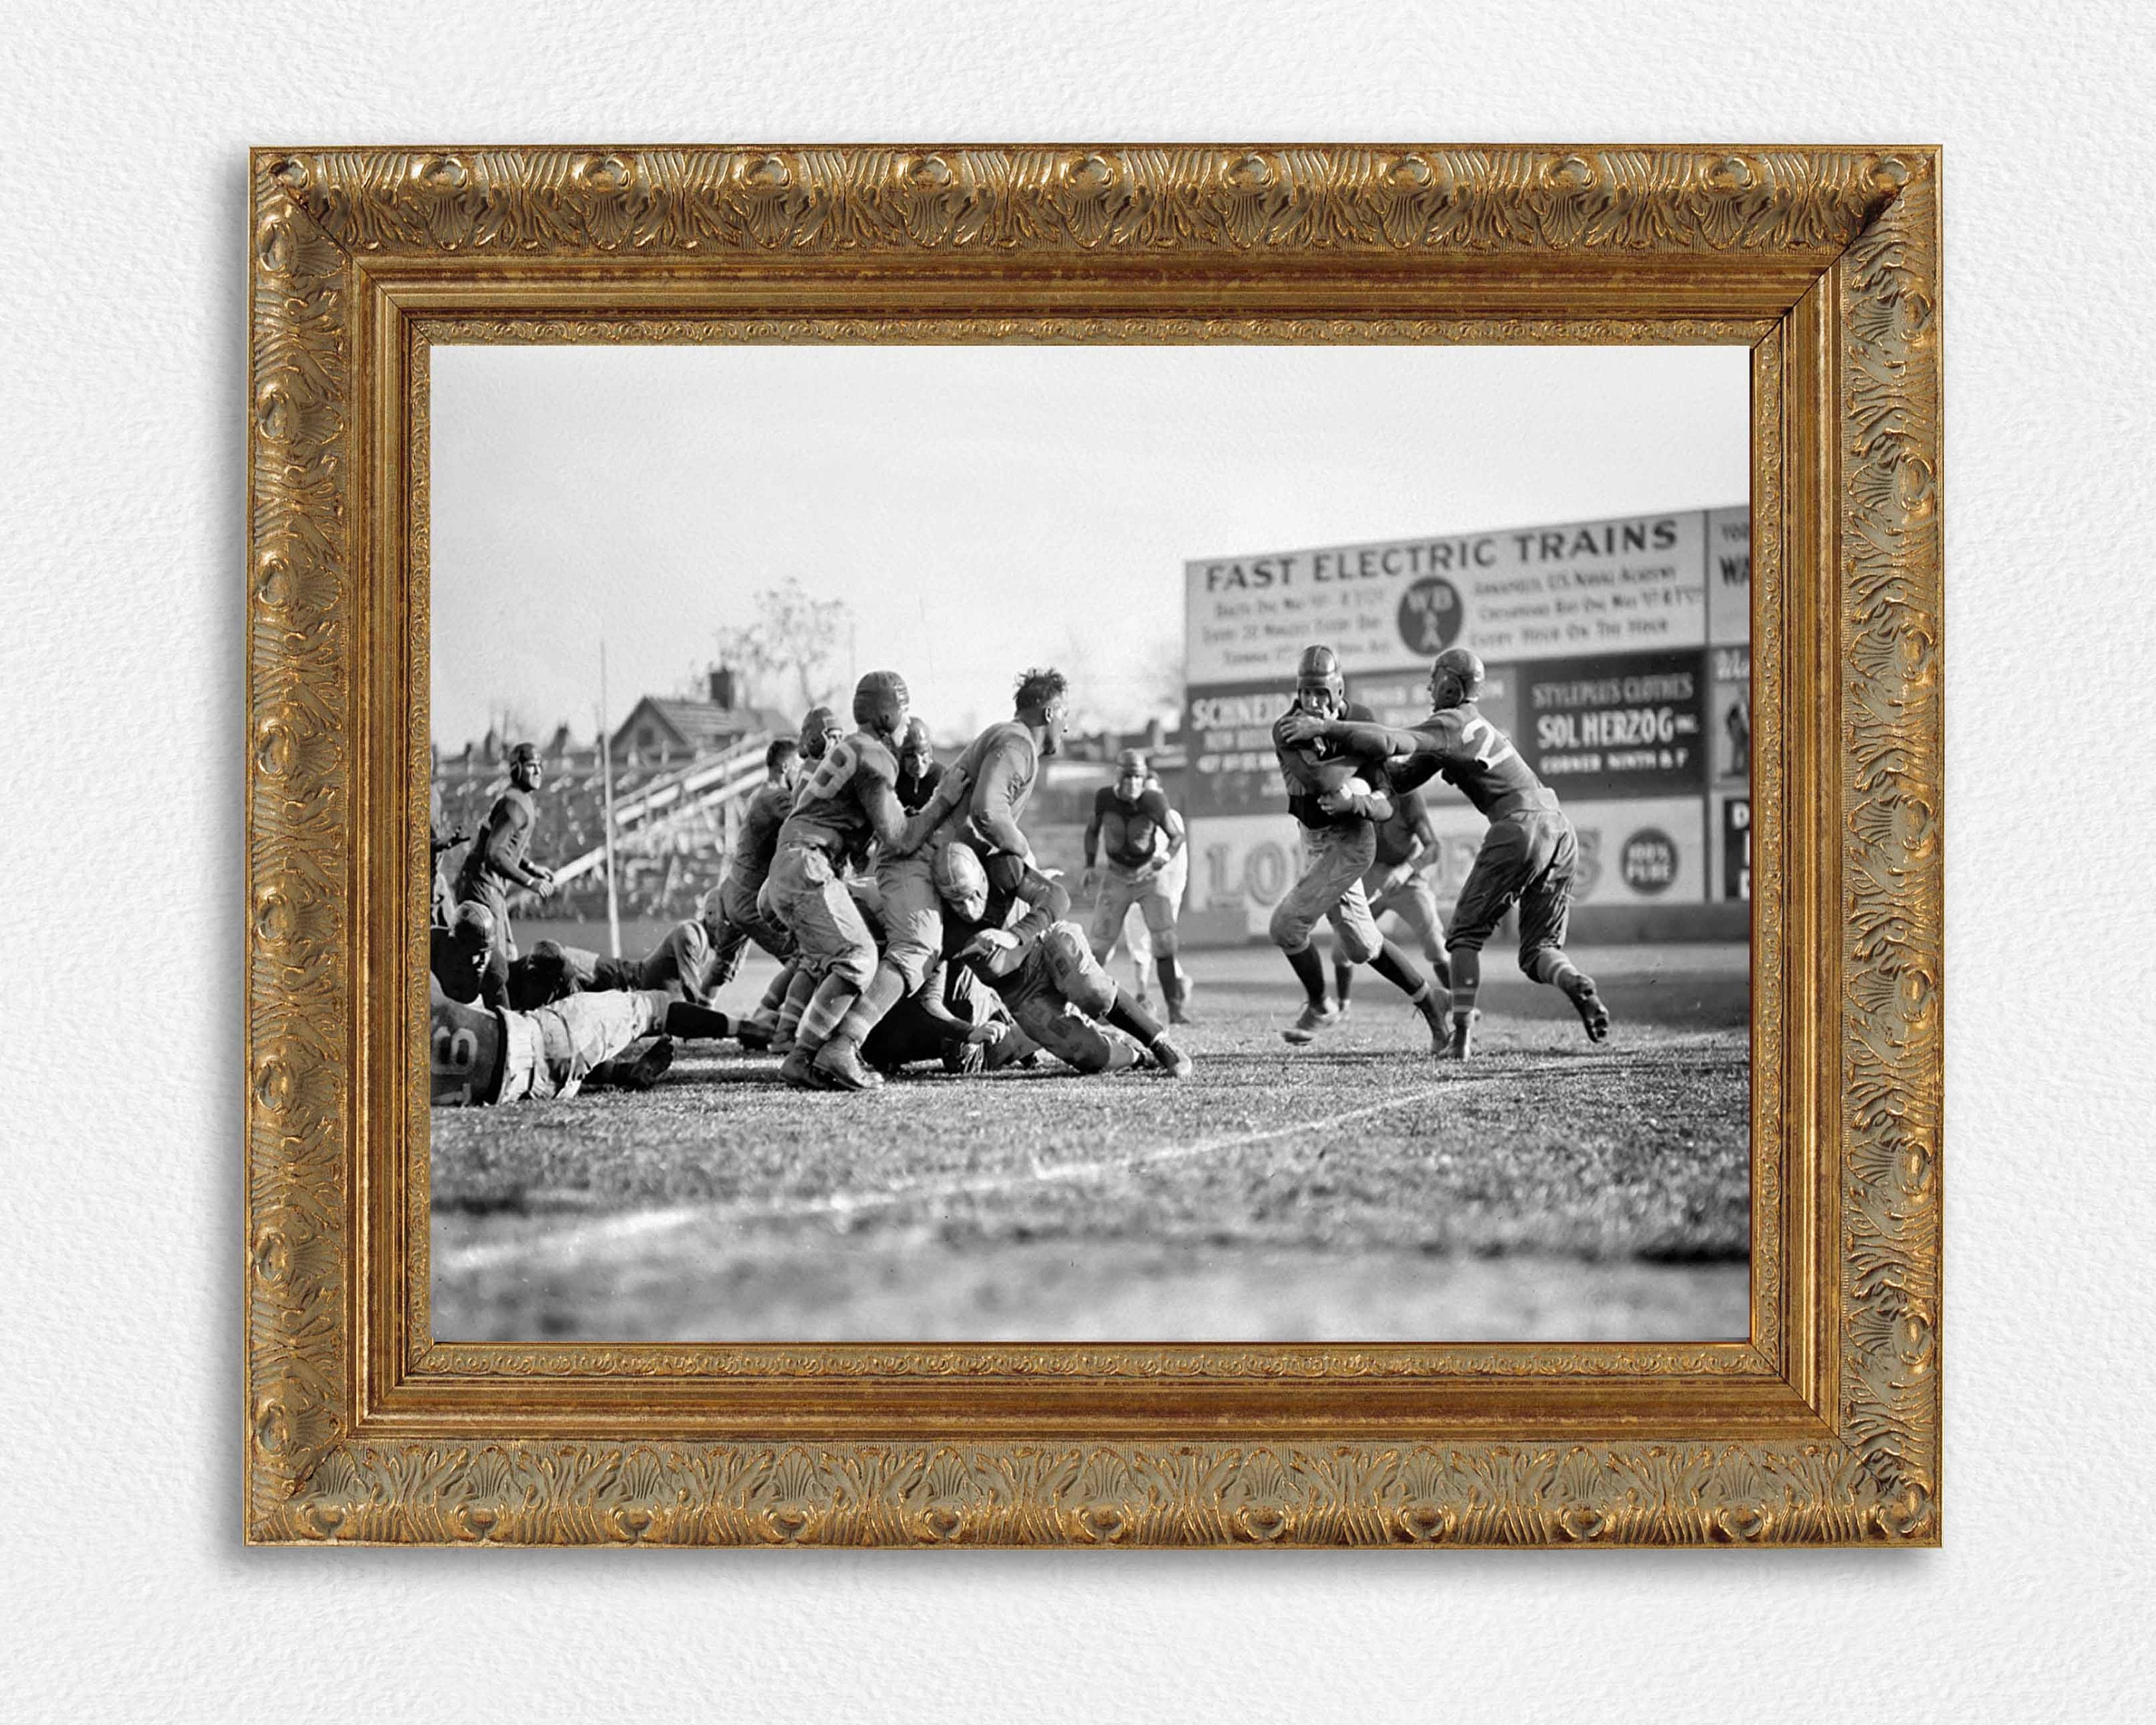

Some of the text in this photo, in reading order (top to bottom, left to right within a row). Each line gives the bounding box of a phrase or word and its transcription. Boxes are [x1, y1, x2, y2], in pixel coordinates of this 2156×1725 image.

[1206, 558, 1296, 592] FAST
[1313, 538, 1497, 583] ELECTRIC
[1513, 519, 1677, 563] TRAINS
[1537, 711, 1581, 750] SOL
[1582, 706, 1674, 748] HERZOG
[810, 742, 857, 800] 8
